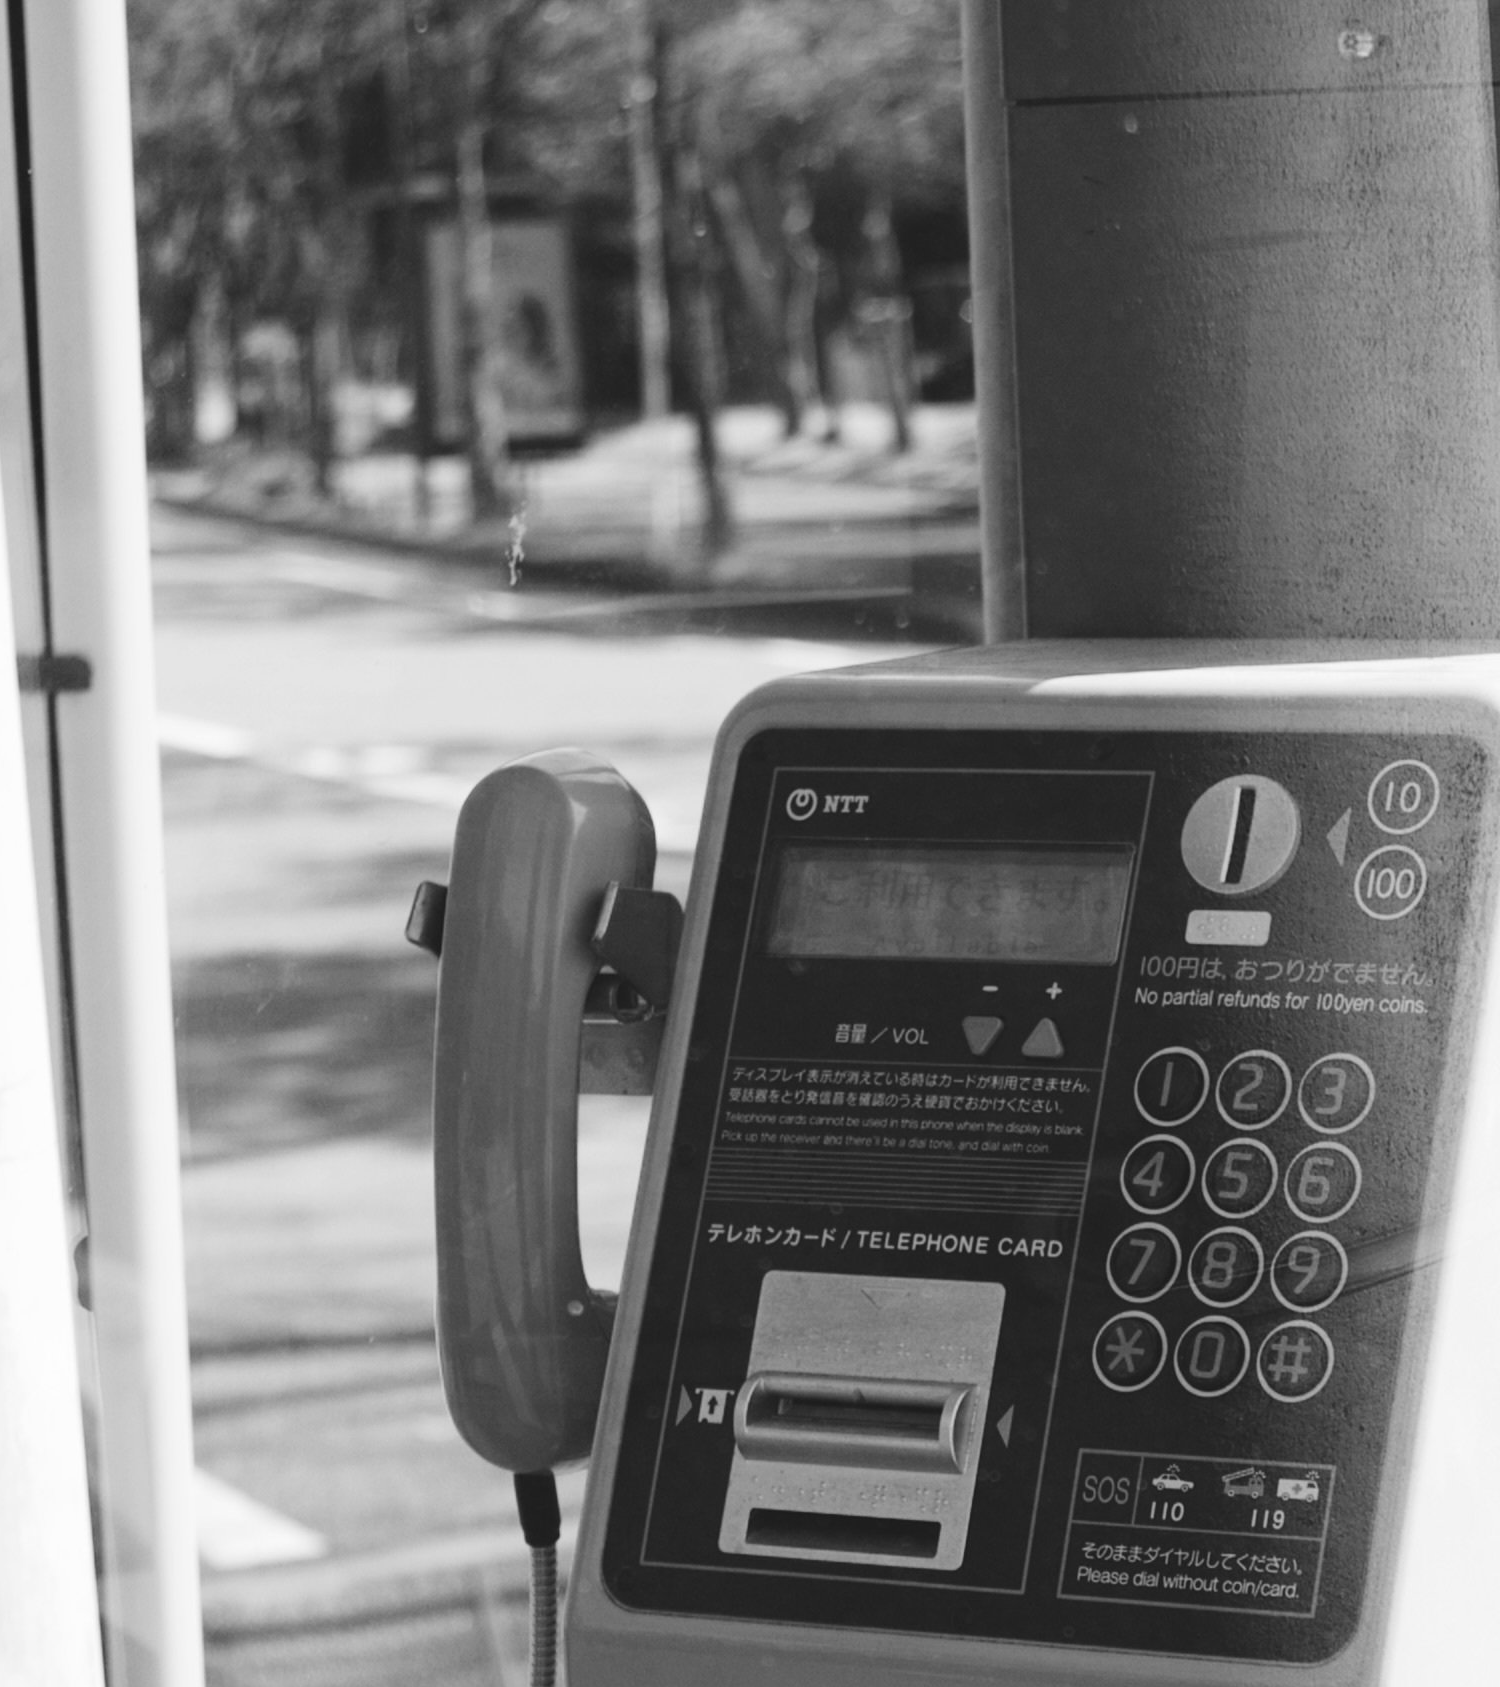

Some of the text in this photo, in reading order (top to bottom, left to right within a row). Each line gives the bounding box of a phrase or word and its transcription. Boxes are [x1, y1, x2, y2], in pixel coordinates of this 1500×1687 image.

[822, 795, 869, 814] NTT
[1386, 780, 1421, 813] 10
[1367, 868, 1415, 899] 100
[1135, 987, 1429, 1015] No partial refunds for 100yen coins.
[834, 1023, 867, 1045] 音量
[892, 1027, 929, 1045] VOL
[1159, 1061, 1347, 1115] 1 2 3
[1132, 1150, 1335, 1205] 4 5 6
[707, 1223, 837, 1248] テレホンカード
[856, 1230, 990, 1255] TELEPHONE
[997, 1237, 1064, 1258] CARD
[1127, 1238, 1320, 1295] 7 8 9
[1188, 1330, 1225, 1379] 0
[1082, 1475, 1130, 1505] SOS
[1150, 1501, 1185, 1522] 110
[1251, 1509, 1285, 1530] 119
[1082, 1541, 1303, 1576] そのままダイヤルしてください。
[1077, 1566, 1300, 1599] Please dial without coin/card.
